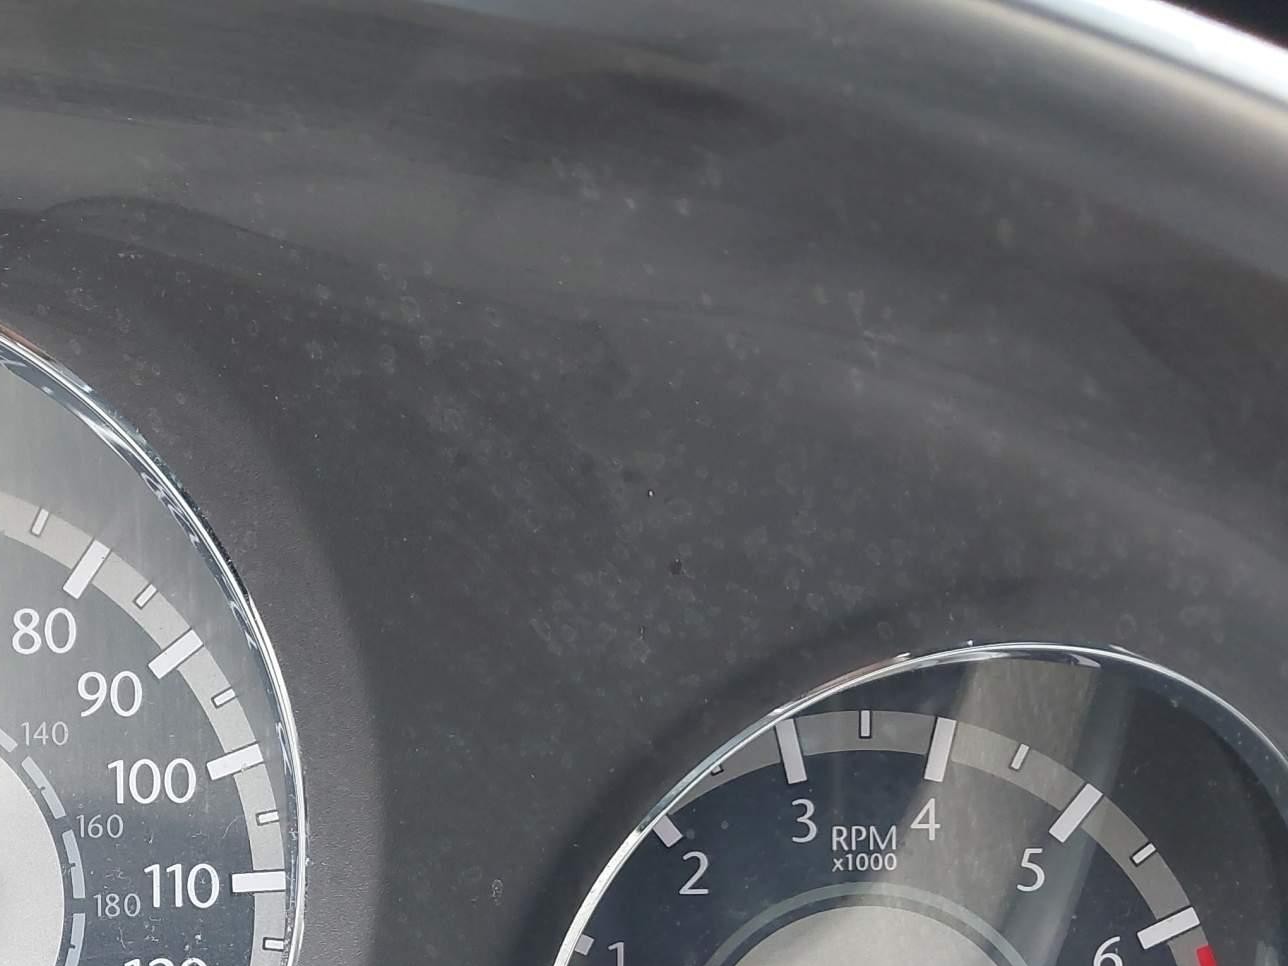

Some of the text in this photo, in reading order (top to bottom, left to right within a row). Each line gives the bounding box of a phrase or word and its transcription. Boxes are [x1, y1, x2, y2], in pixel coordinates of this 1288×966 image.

[12, 608, 76, 654] 80
[78, 671, 143, 717] 90
[22, 722, 69, 745] 140
[108, 759, 196, 803] 100
[78, 814, 123, 838] 160
[792, 799, 817, 842] 3
[832, 826, 897, 850] RPM
[911, 798, 940, 841] 4
[680, 852, 709, 895] 2
[832, 854, 897, 872] x1000
[1017, 849, 1044, 892] 5
[94, 894, 140, 917] 180
[144, 864, 219, 908] 110
